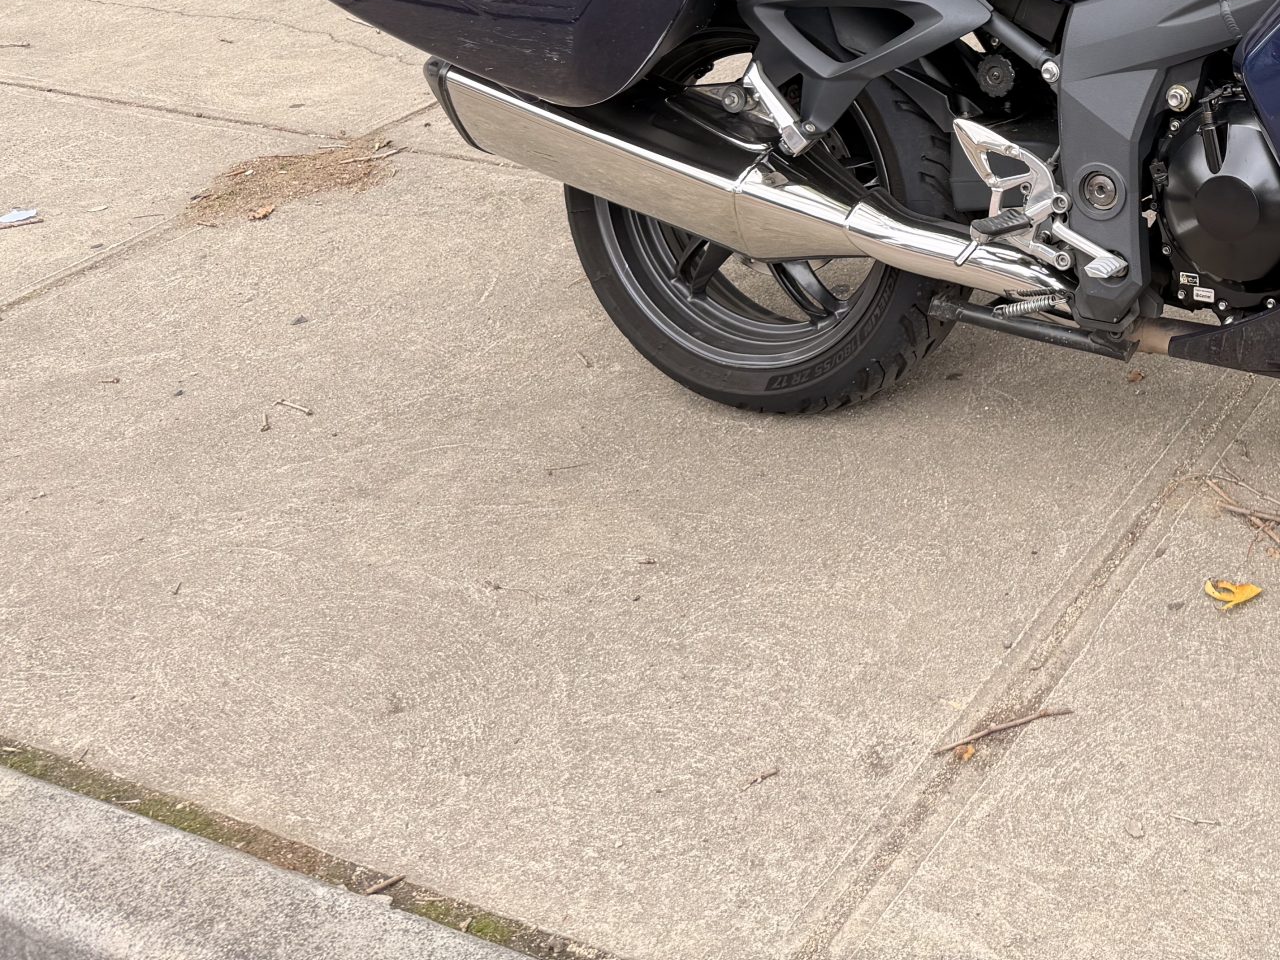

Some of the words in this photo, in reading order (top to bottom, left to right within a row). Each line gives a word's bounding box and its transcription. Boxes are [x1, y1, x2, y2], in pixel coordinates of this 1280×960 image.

[863, 268, 898, 338] ICHELIN
[814, 342, 858, 377] 180/55
[772, 376, 789, 389] 17
[792, 371, 809, 384] ZR
